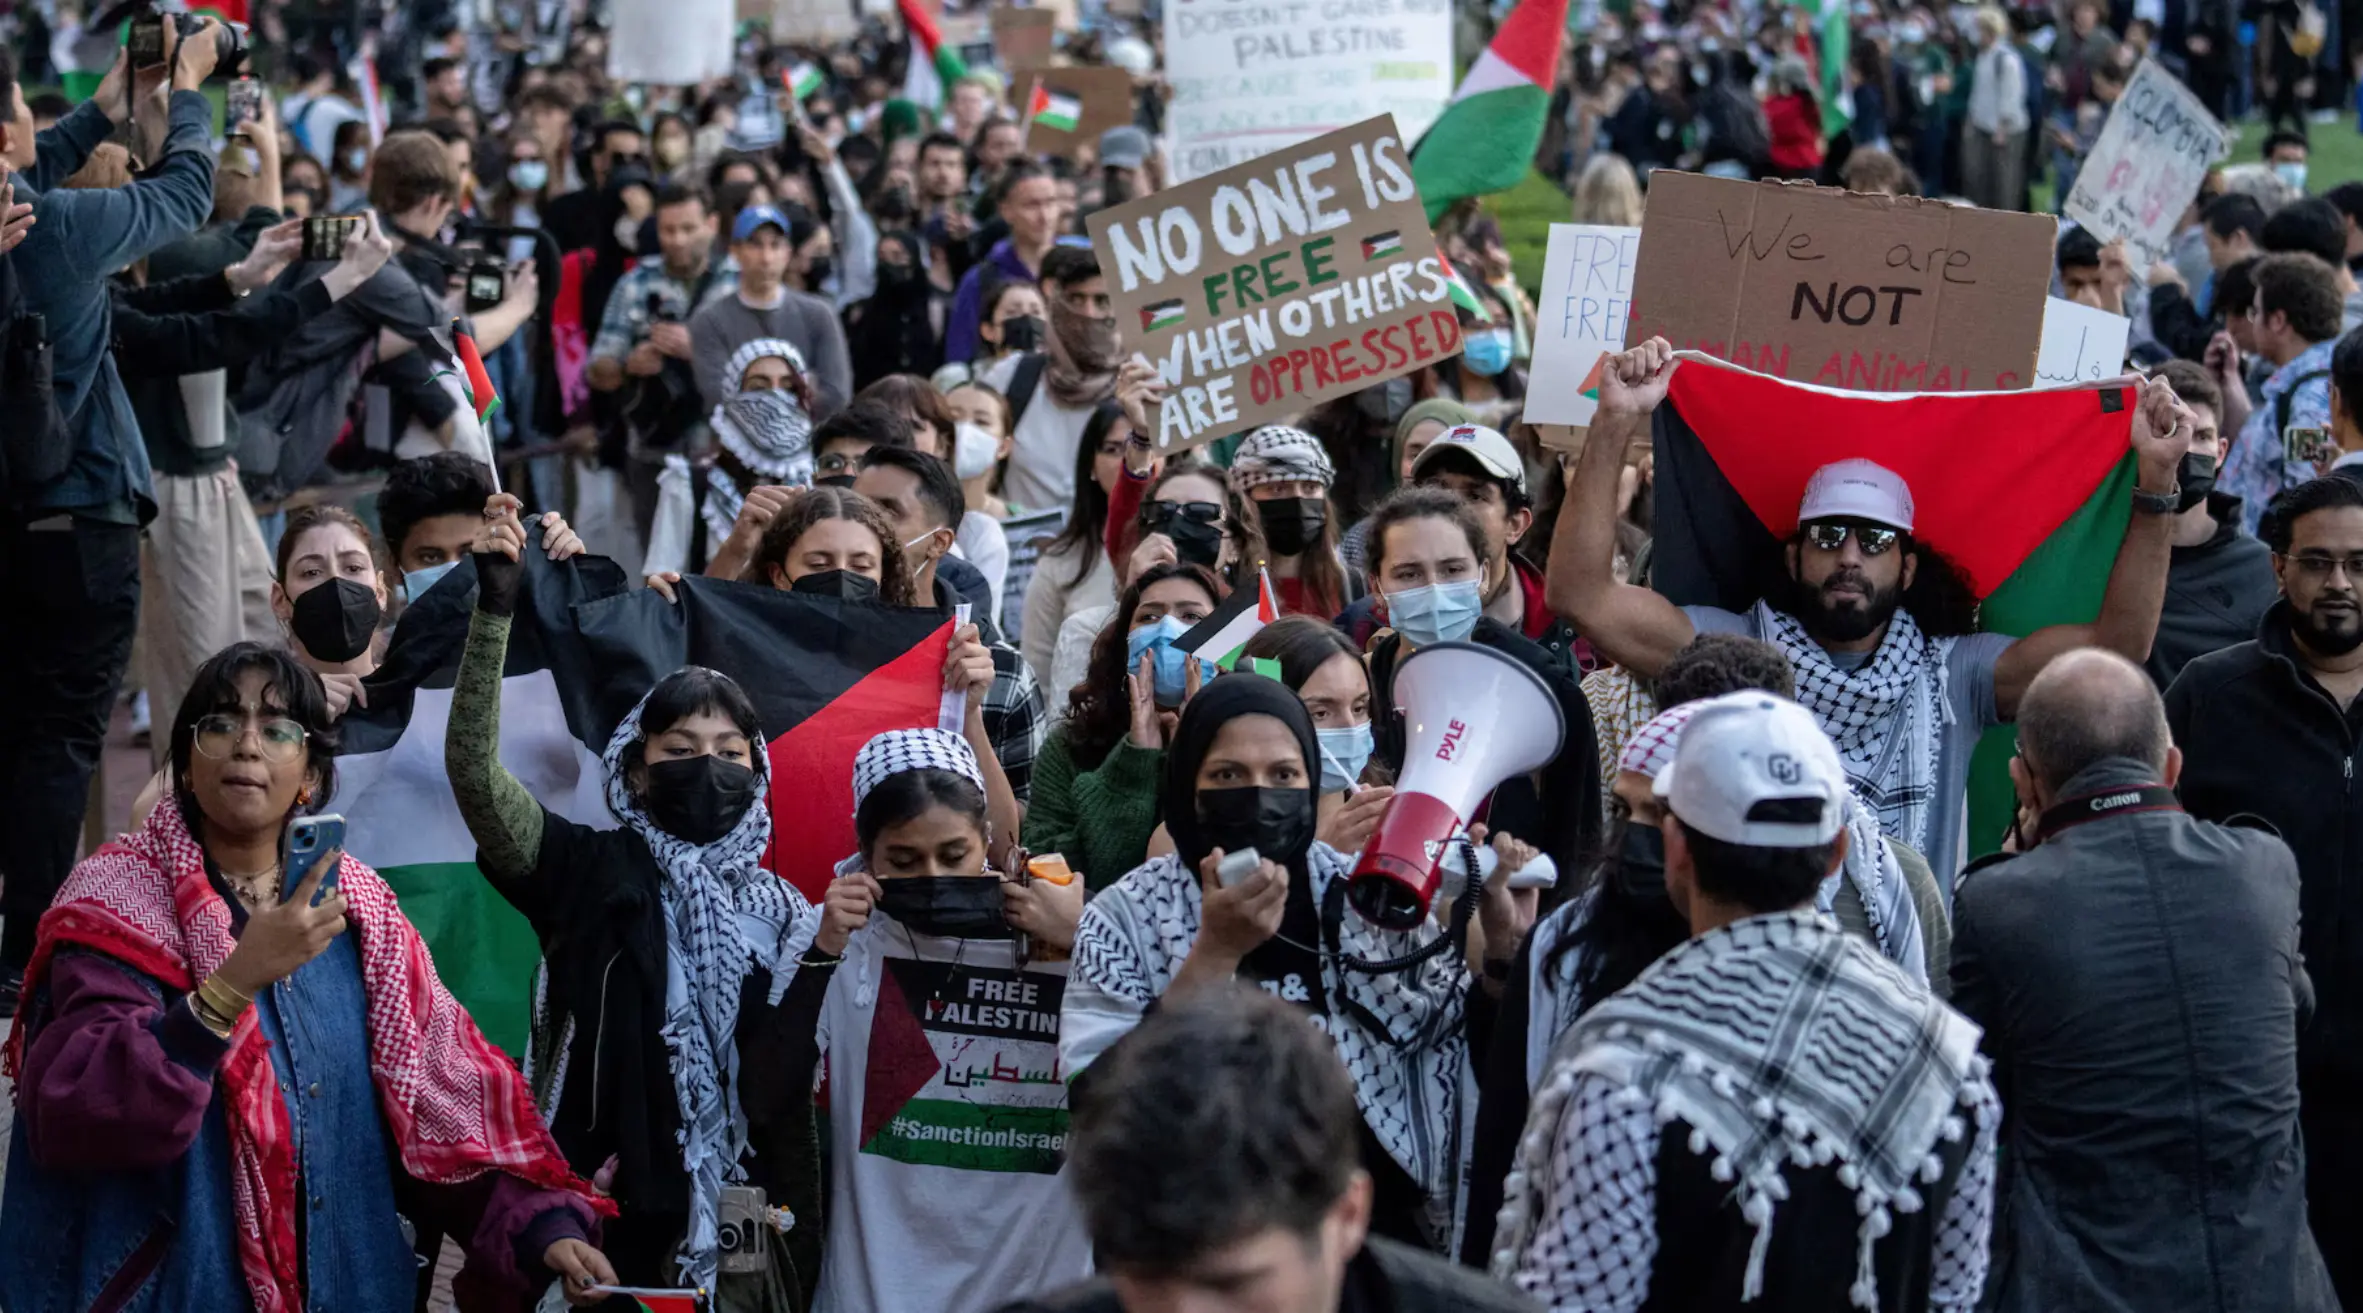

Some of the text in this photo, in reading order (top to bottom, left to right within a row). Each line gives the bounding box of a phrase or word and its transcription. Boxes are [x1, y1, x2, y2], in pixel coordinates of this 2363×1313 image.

[1233, 25, 1407, 68] PALESTINE
[1107, 206, 1201, 292] NO
[1211, 153, 1351, 257] ONE
[1350, 136, 1415, 210] IS
[1568, 234, 1637, 293] FRE
[1717, 208, 1976, 285] We are
[1202, 236, 1339, 316] FREE
[1132, 257, 1450, 387] WHEN OTHERS
[1791, 281, 1922, 327] NOT
[1636, 325, 1790, 378] MAN
[1159, 311, 1459, 448] ARE OPPRESSED
[1435, 718, 1466, 761] PYLE
[2089, 791, 2142, 812] Canon
[967, 977, 1039, 1005] FREE
[924, 999, 1059, 1034] ALESTIN
[891, 1115, 1069, 1151] #SanctionIsrael
